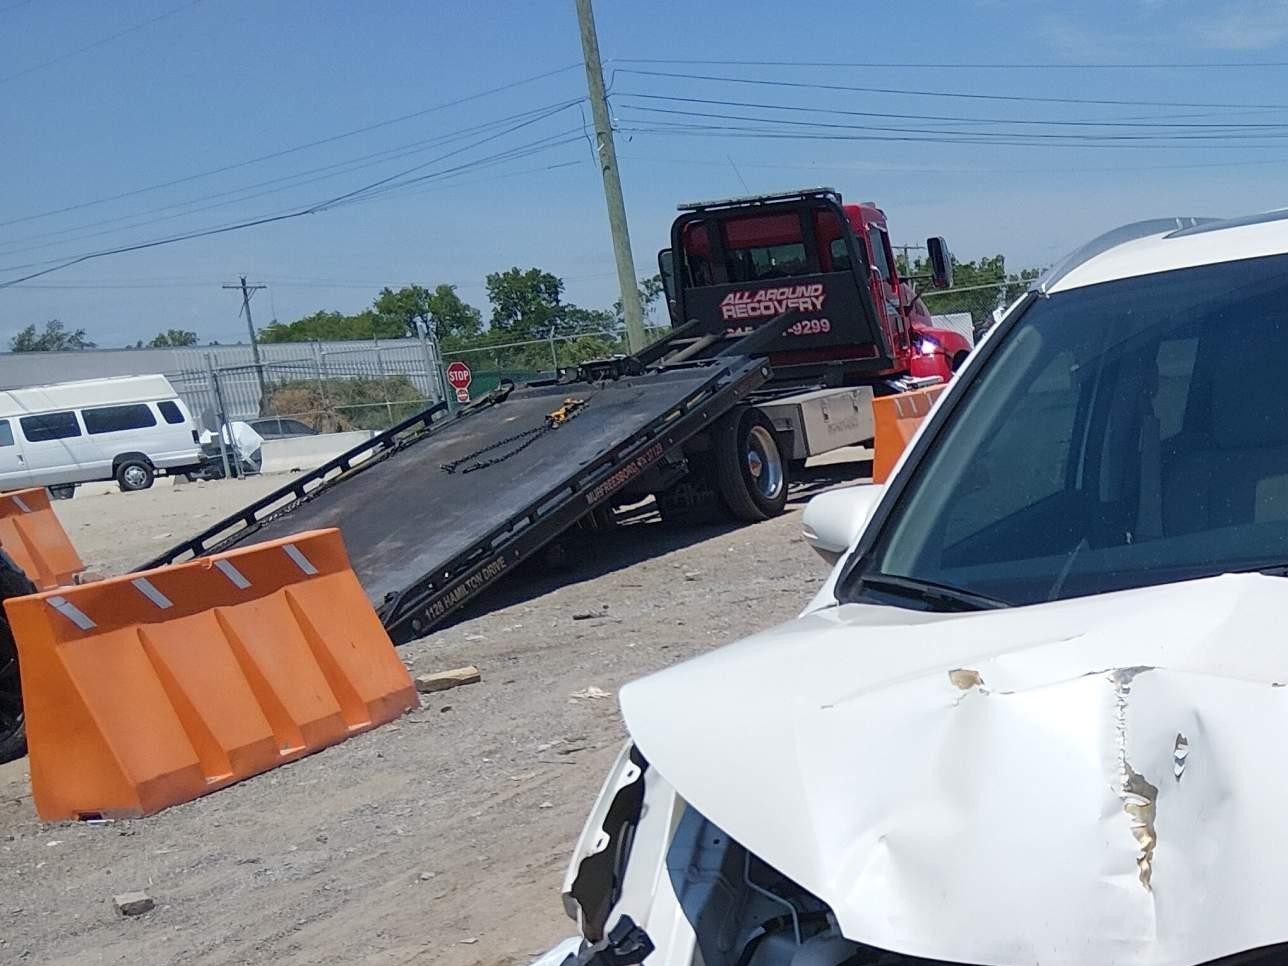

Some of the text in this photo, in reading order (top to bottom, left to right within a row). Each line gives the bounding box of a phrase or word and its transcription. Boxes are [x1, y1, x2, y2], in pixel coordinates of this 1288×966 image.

[721, 284, 823, 305] ALL AROUND
[721, 296, 826, 319] RECOVERY
[449, 371, 469, 382] STOP
[442, 572, 484, 609] HAMILTON
[481, 555, 507, 581] DRIVE
